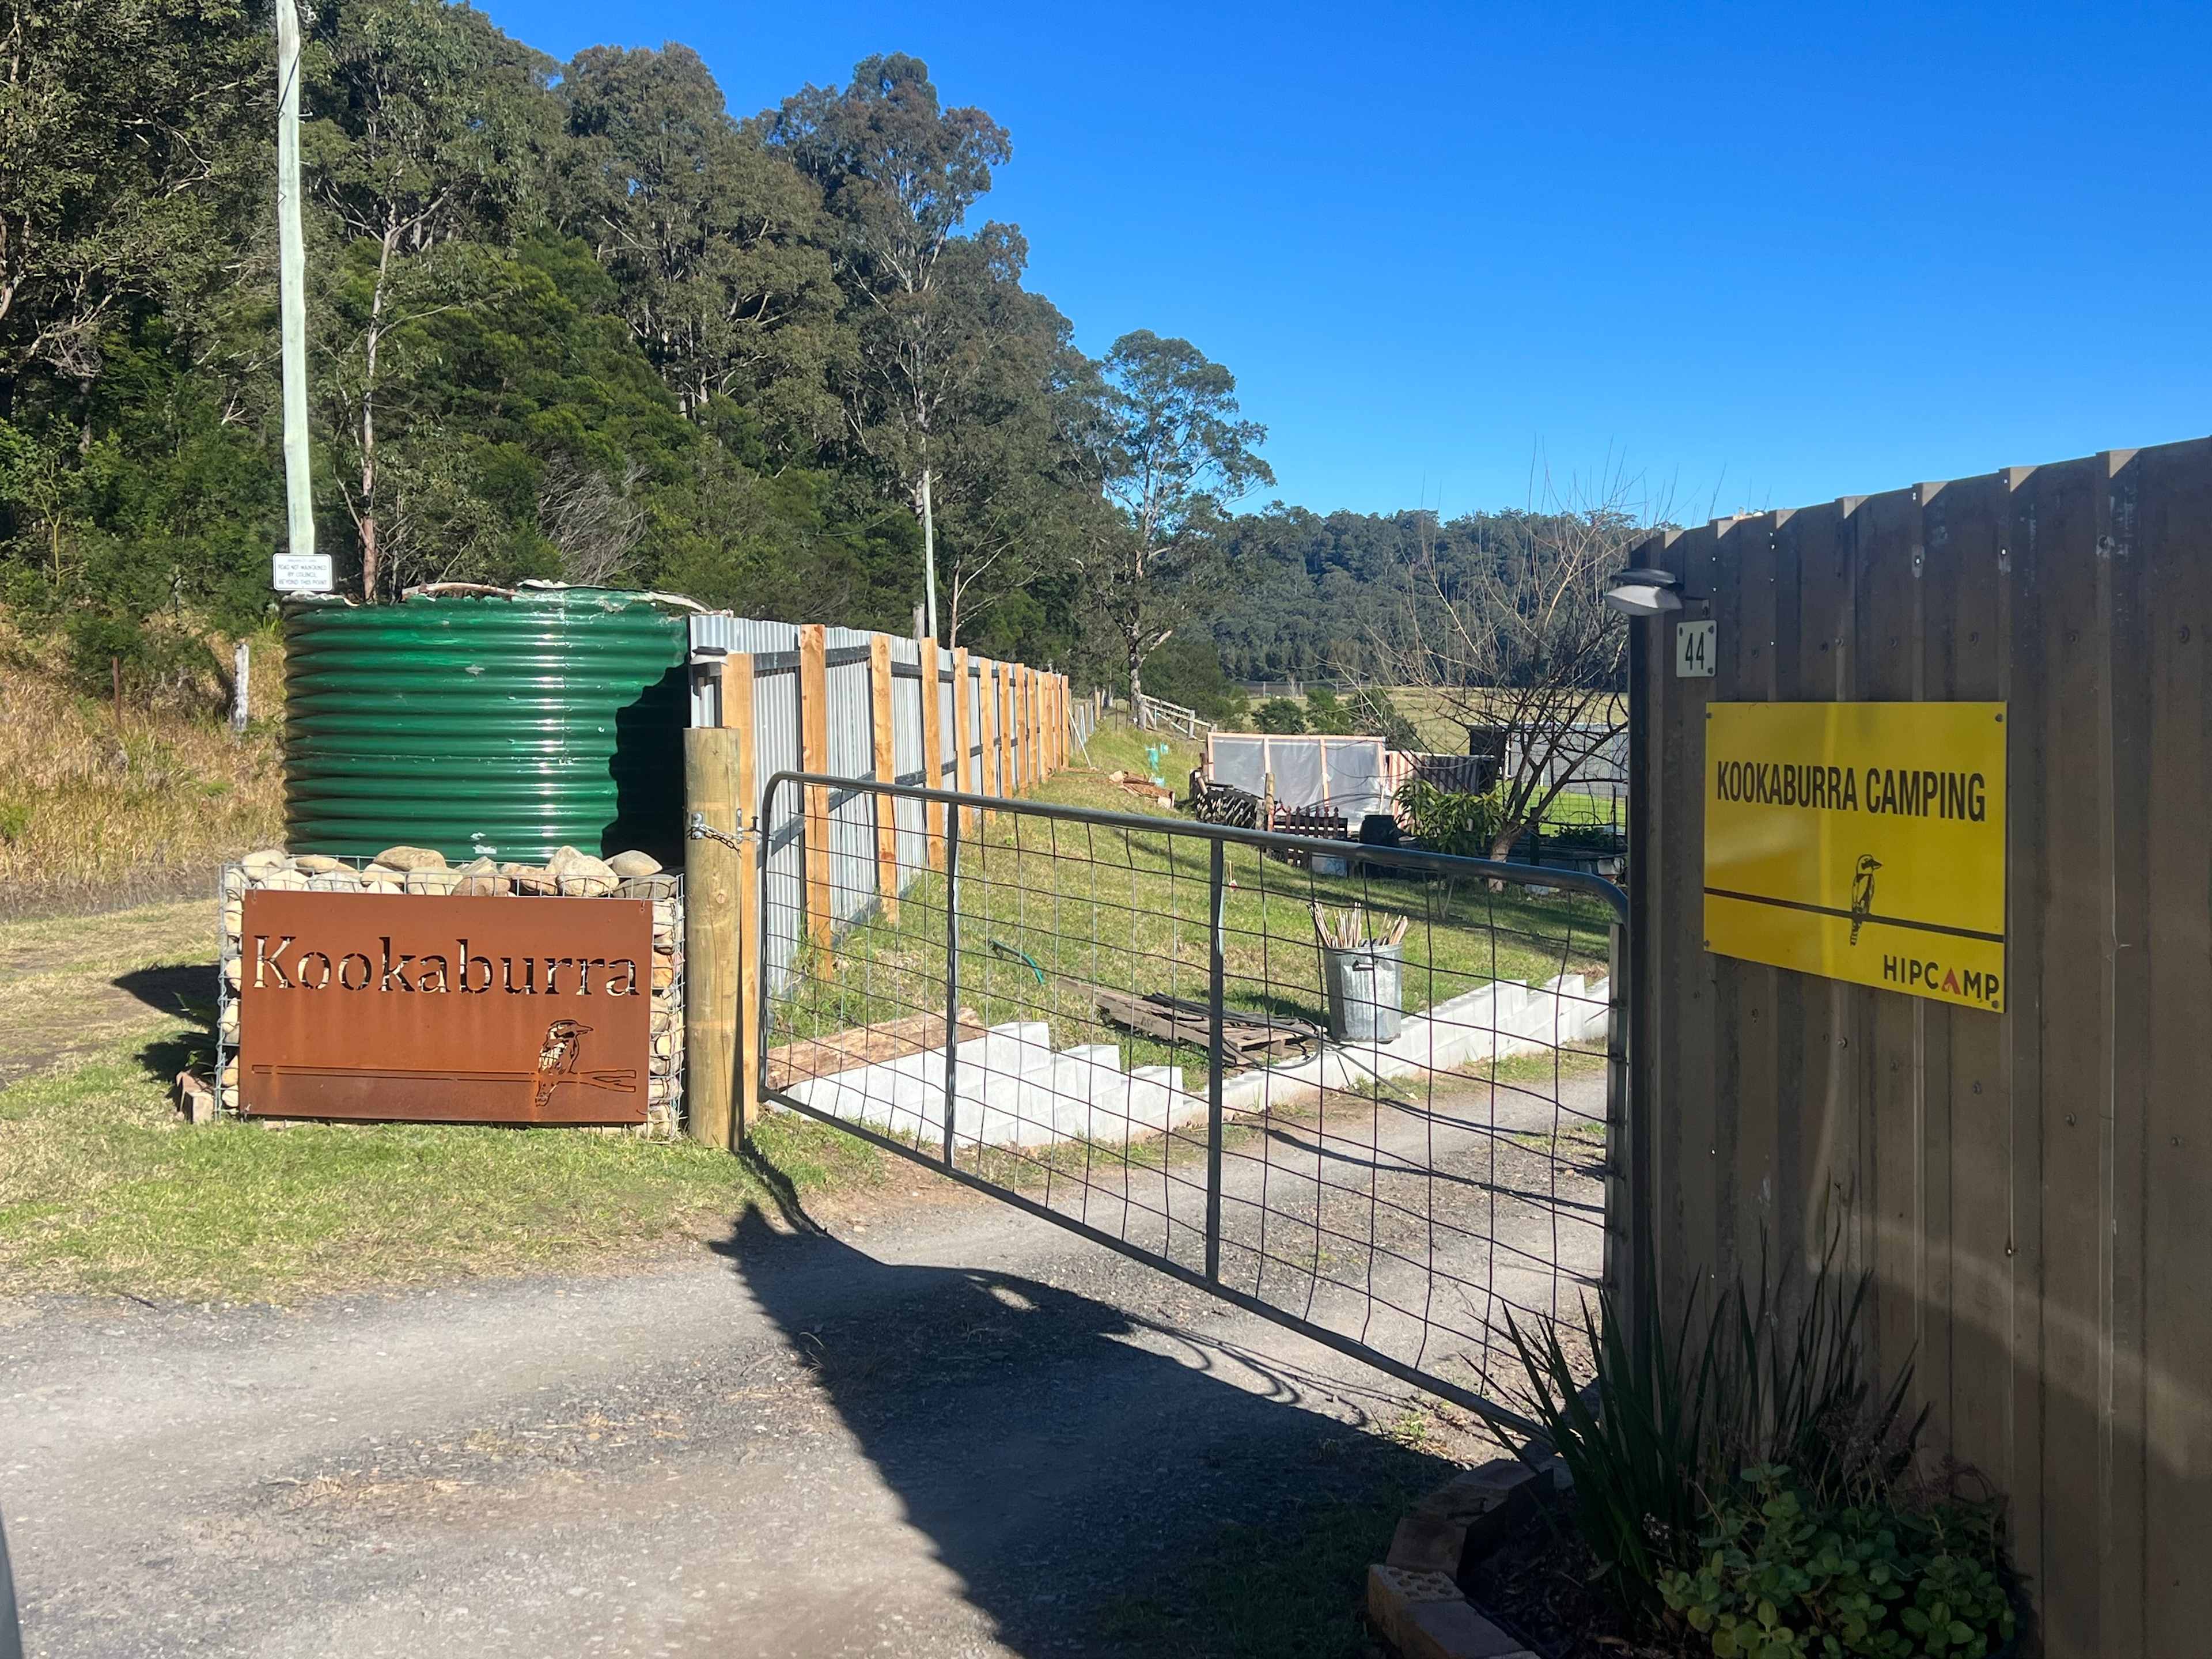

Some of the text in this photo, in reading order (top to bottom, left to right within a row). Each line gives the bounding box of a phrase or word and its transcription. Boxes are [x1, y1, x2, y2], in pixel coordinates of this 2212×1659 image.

[1685, 631, 1705, 671] 44
[1717, 760, 1986, 822] KOOKABURRA CAMPING
[253, 934, 640, 997] Kookaburra
[1883, 954, 2000, 1002] HIPCAMP
